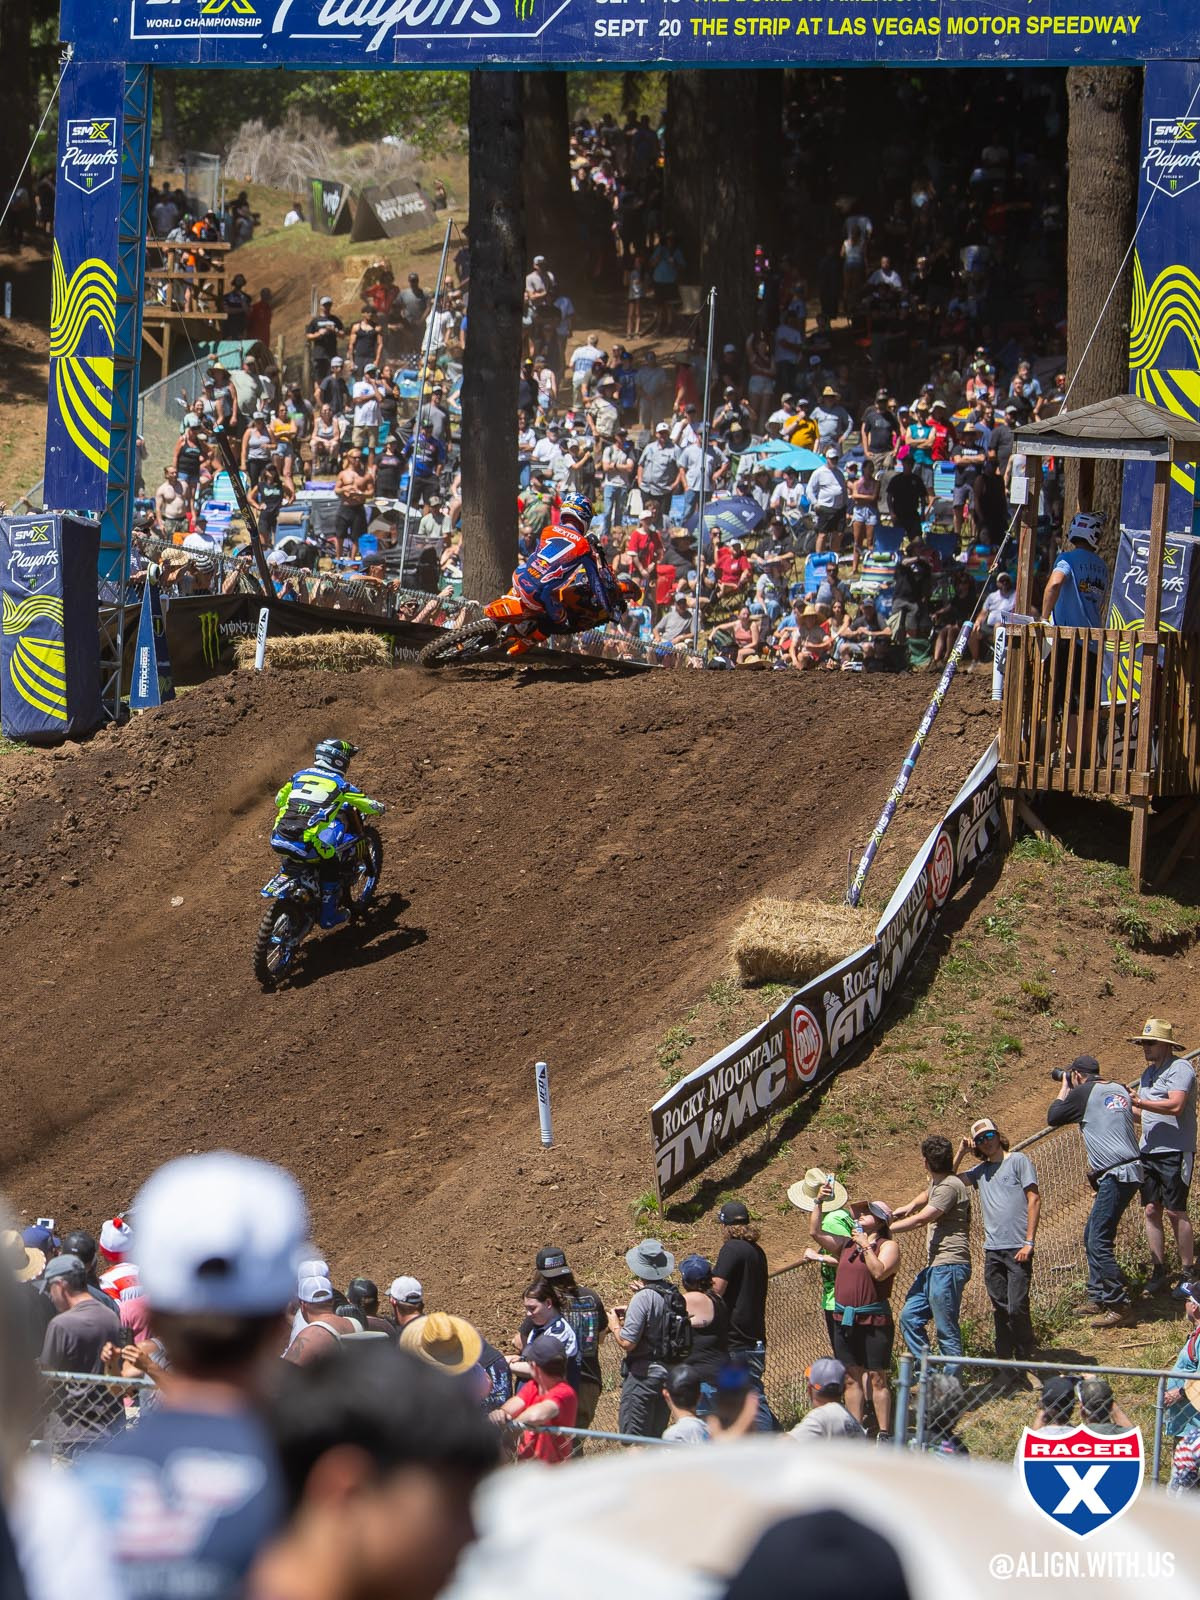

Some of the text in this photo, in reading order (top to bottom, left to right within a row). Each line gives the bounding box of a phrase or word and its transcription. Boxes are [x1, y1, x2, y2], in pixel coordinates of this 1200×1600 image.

[146, 18, 262, 28] WORLD CHAMPIONSHIP
[594, 16, 1141, 37] SEPT 20 THE STRIP AT LAS VEGAS MOTOR SPEEDWAY
[72, 123, 110, 139] SMX
[1154, 122, 1197, 139] SMX
[61, 147, 118, 171] Playoffs
[14, 525, 49, 542] SMX
[552, 526, 581, 542] SEXTON
[537, 536, 576, 563] 1
[1137, 546, 1179, 565] SX
[7, 550, 59, 573] Playoffs
[1122, 566, 1184, 593] Plaoffs
[394, 645, 420, 663] MONS
[288, 774, 337, 804] 3
[972, 779, 999, 821] ROCK
[842, 960, 879, 1003] ROCK
[661, 1087, 706, 1143] ROCKY
[708, 1030, 783, 1106] MOUNTAIN
